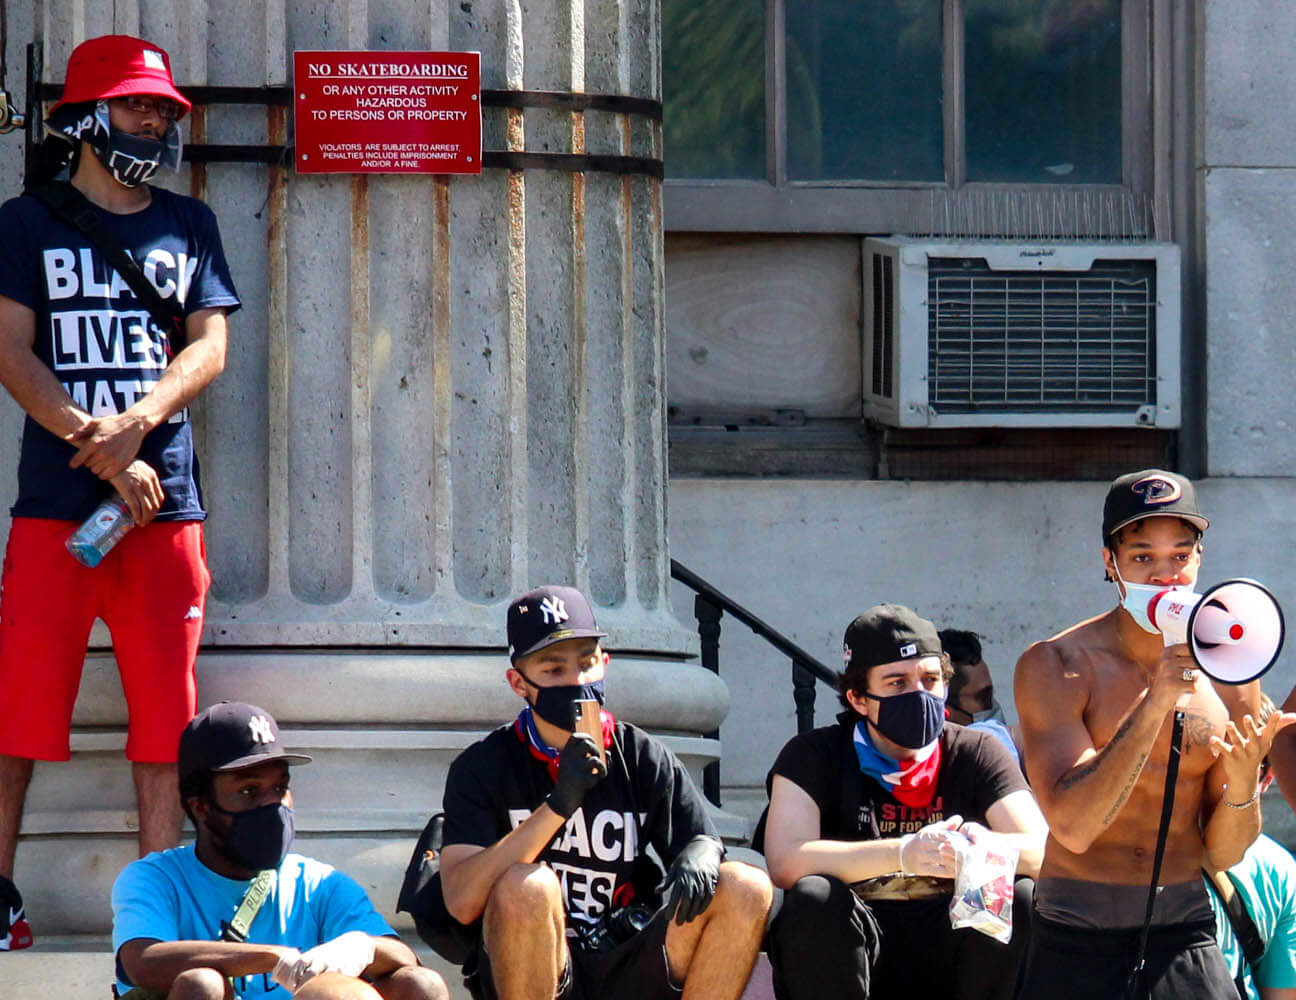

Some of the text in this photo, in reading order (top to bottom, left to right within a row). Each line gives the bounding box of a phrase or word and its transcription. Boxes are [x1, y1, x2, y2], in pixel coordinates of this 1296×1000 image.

[308, 63, 469, 77] NO SKATEBOARDING
[322, 85, 459, 96] OR ANY OTHER ACTIVITY
[356, 98, 427, 108] HAZARDOUS
[312, 110, 468, 121] TO PERSONS OR PROPERTY
[319, 143, 362, 152] VIOLATORS
[364, 143, 381, 151] ARE
[382, 143, 417, 152] SUBJECT
[418, 143, 430, 152] TO
[322, 151, 458, 160] PENALTIES INCLUDE IMPRISONMENT
[393, 160, 401, 168] A
